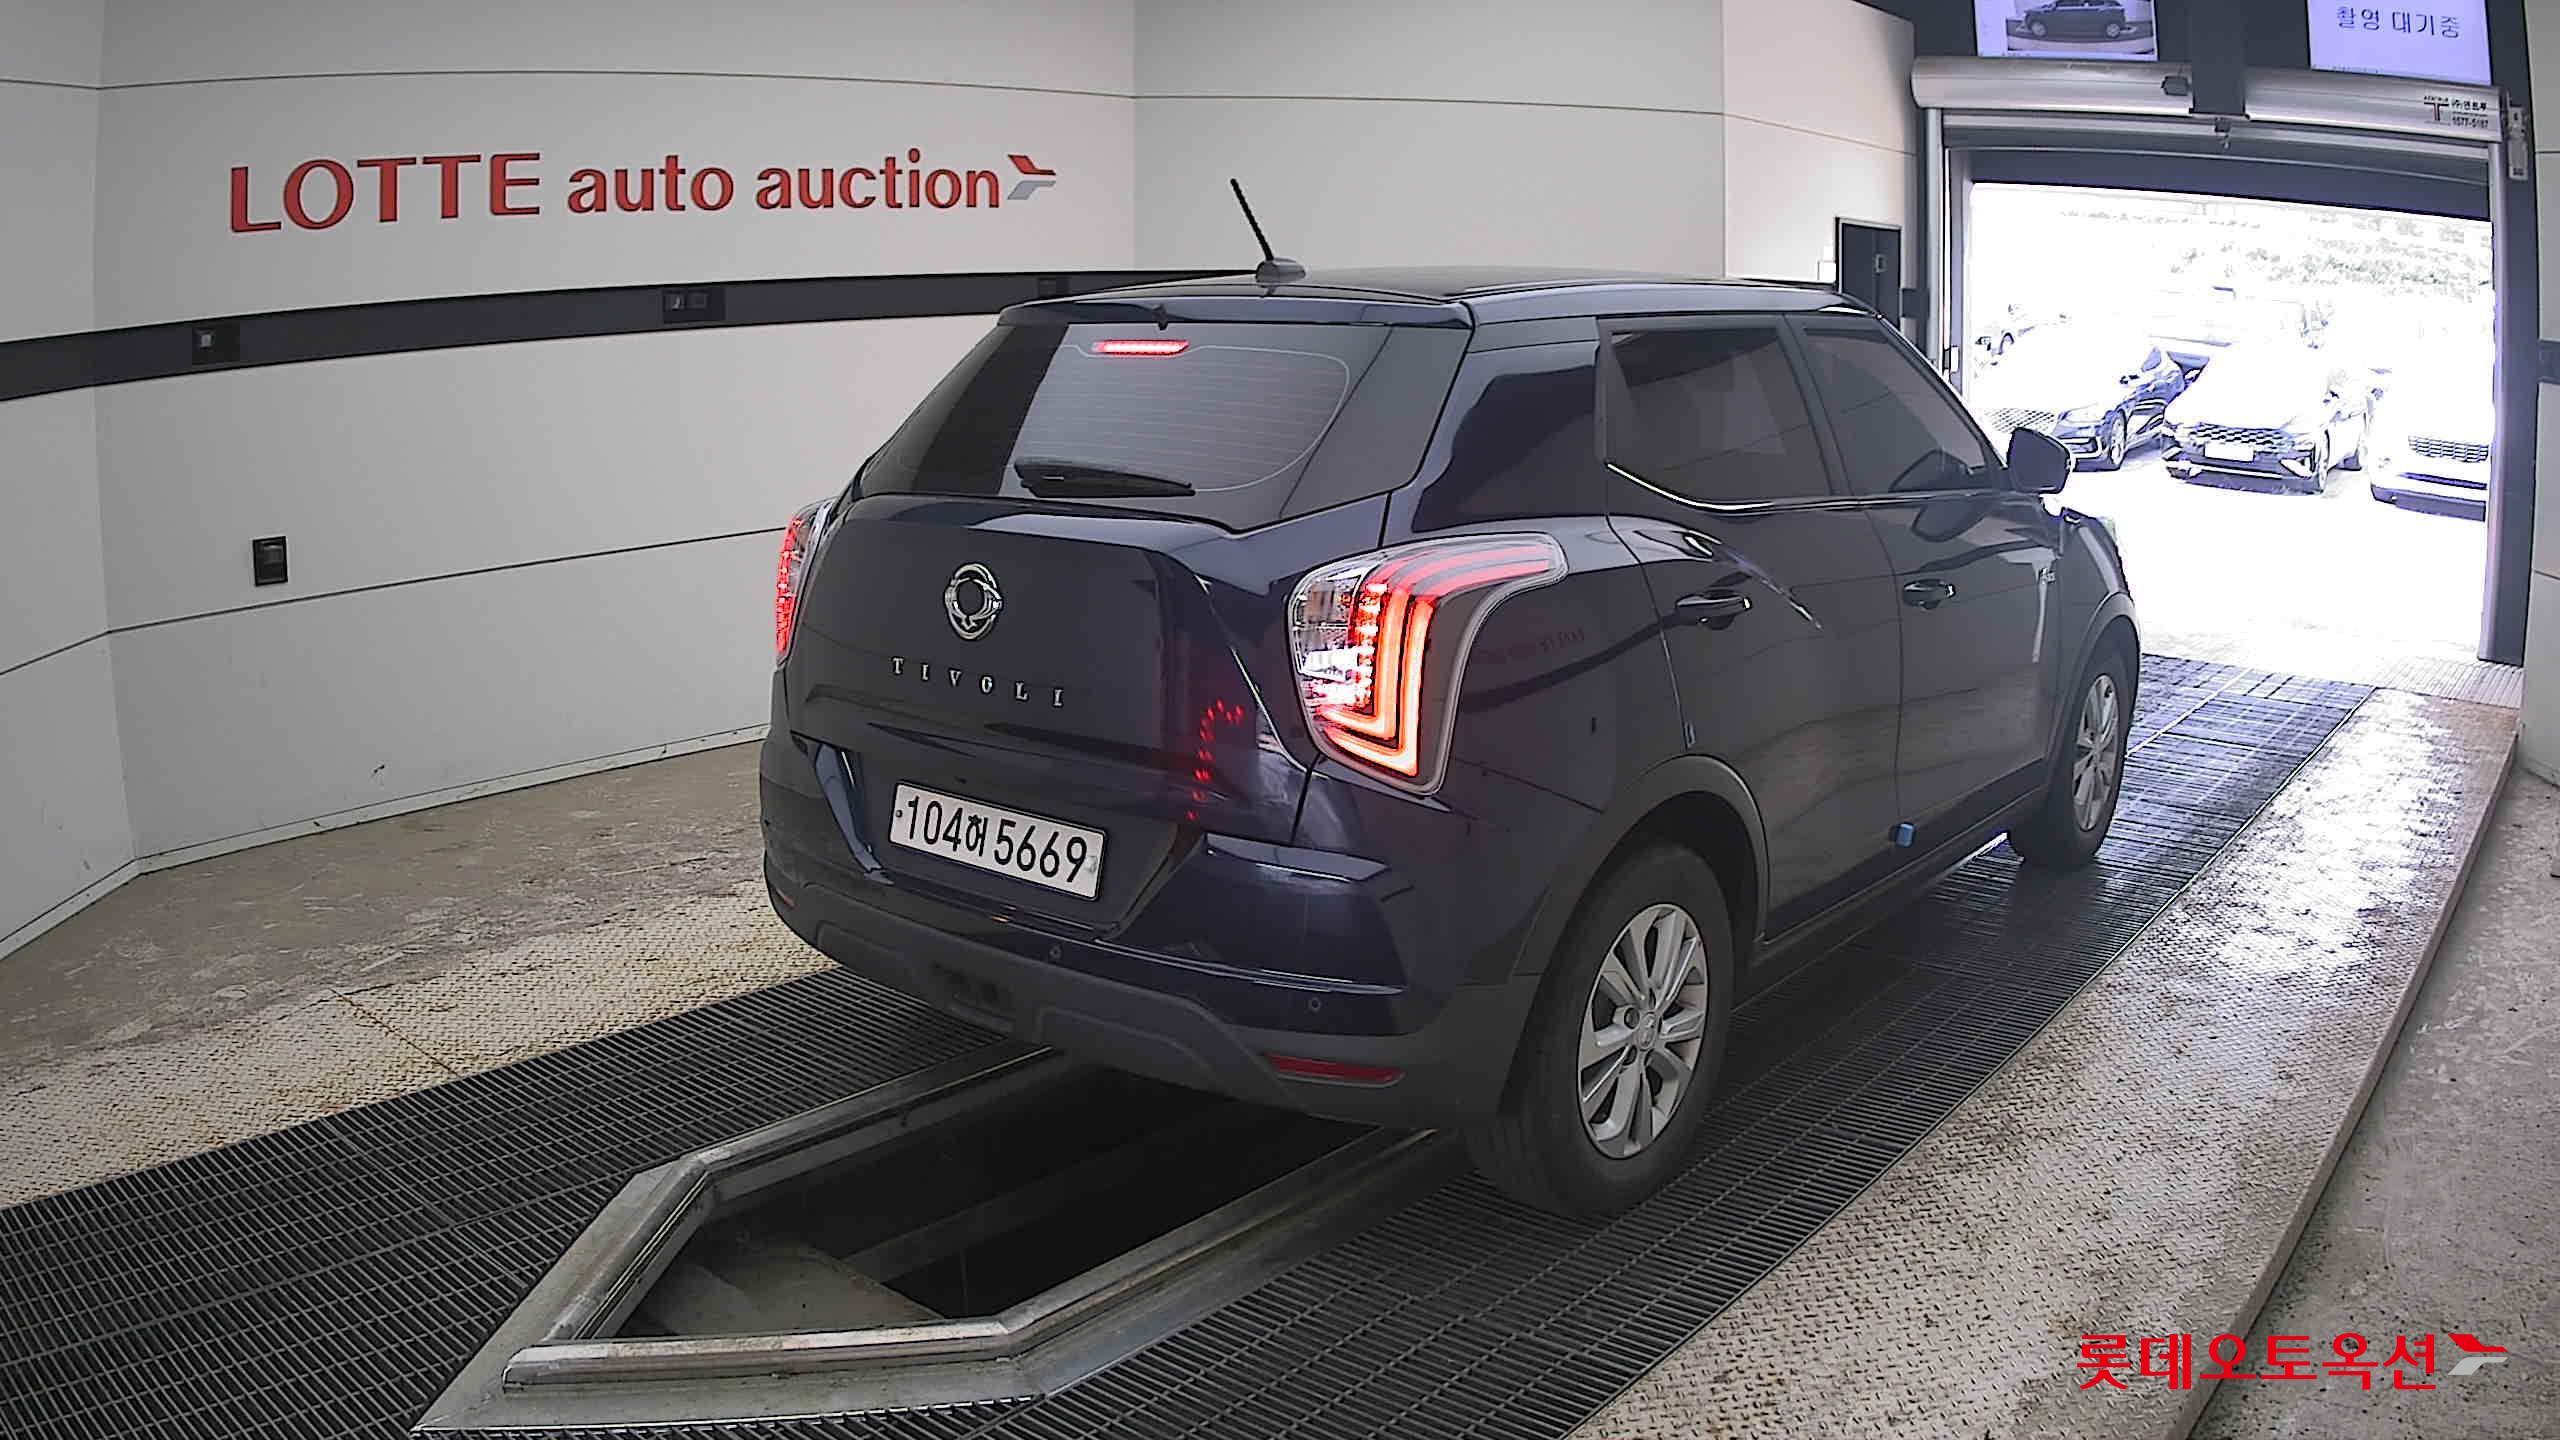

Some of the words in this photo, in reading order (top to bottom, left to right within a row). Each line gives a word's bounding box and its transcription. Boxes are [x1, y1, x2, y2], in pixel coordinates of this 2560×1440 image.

[2337, 6, 2381, 31] 촬영
[2392, 11, 2461, 39] 대기중
[230, 152, 541, 233] LOTTE
[566, 153, 735, 214] auto
[756, 147, 1001, 210] auction
[891, 657, 1065, 707] TIVOLI
[907, 795, 989, 858] 104허
[993, 818, 1088, 884] 5669
